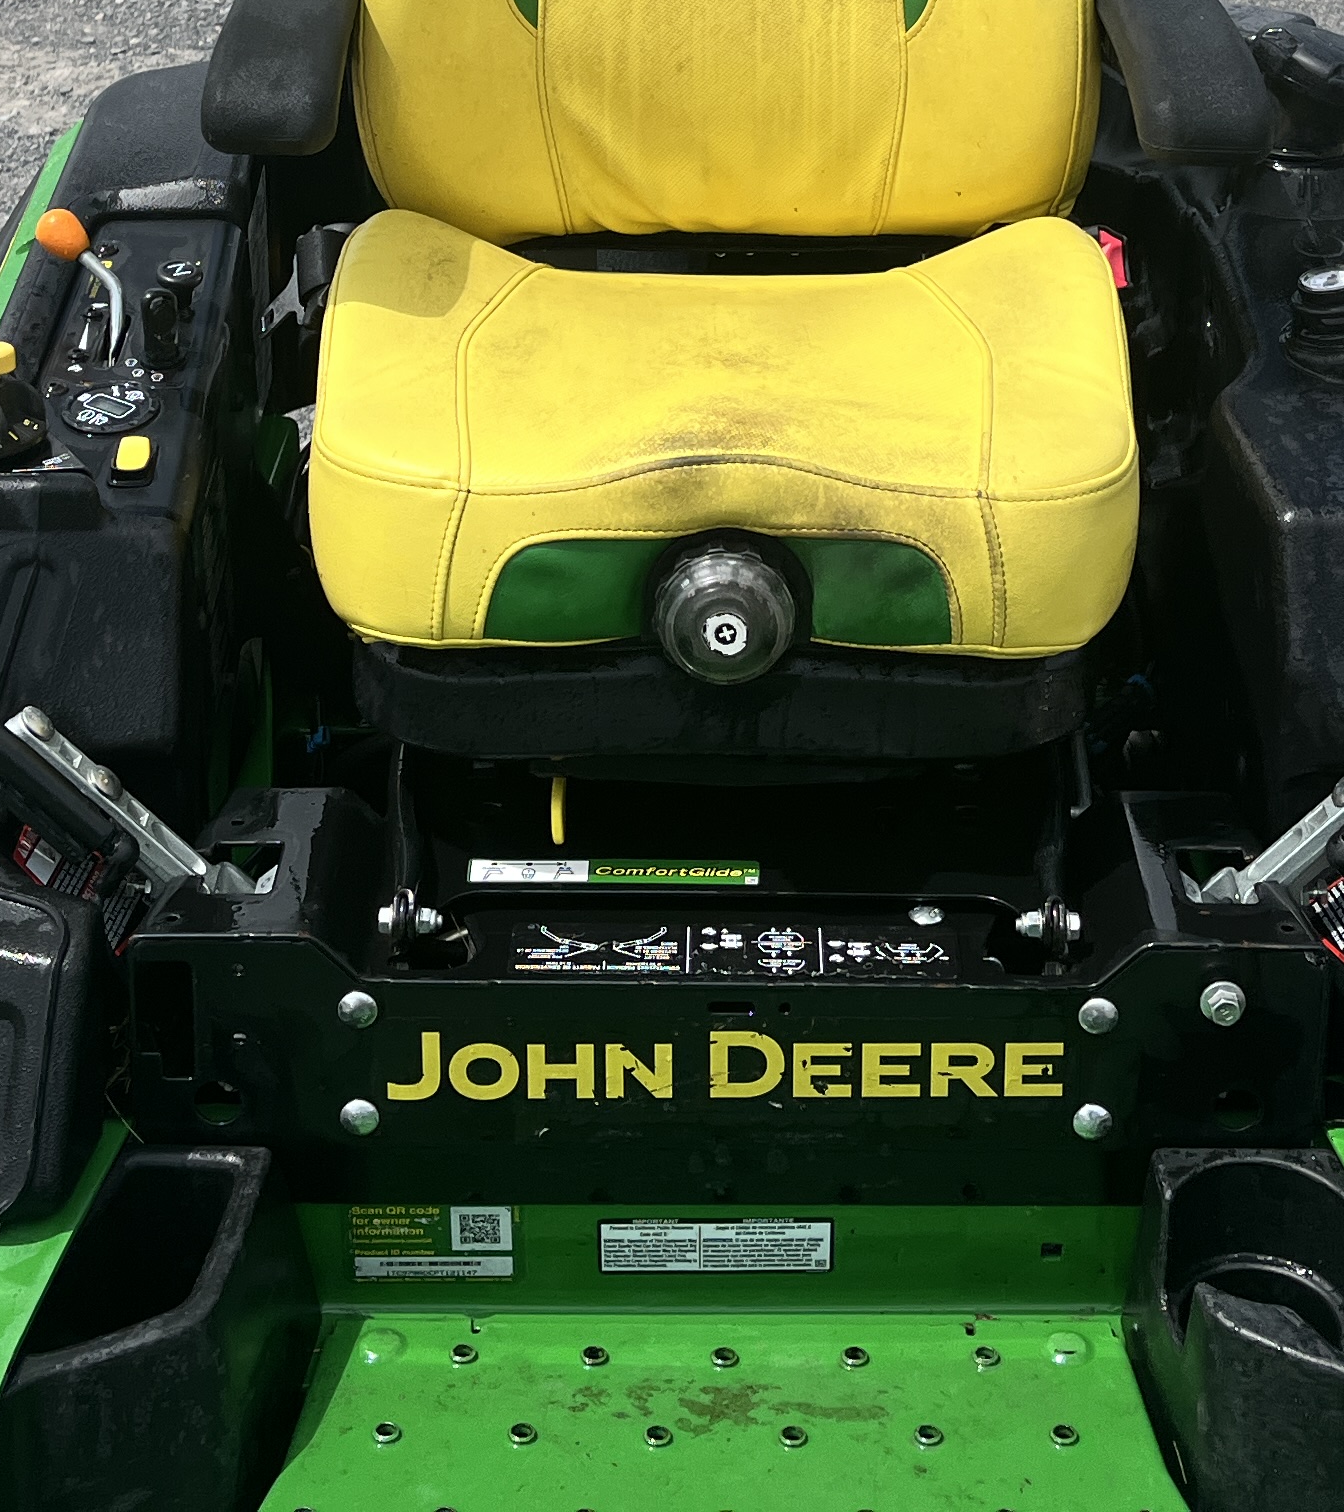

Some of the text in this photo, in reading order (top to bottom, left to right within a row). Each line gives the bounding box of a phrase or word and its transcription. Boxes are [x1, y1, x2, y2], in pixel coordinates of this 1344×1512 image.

[386, 1030, 1064, 1100] JOHN DEERE
[351, 1205, 440, 1215] Scan QR code
[352, 1216, 370, 1225] for
